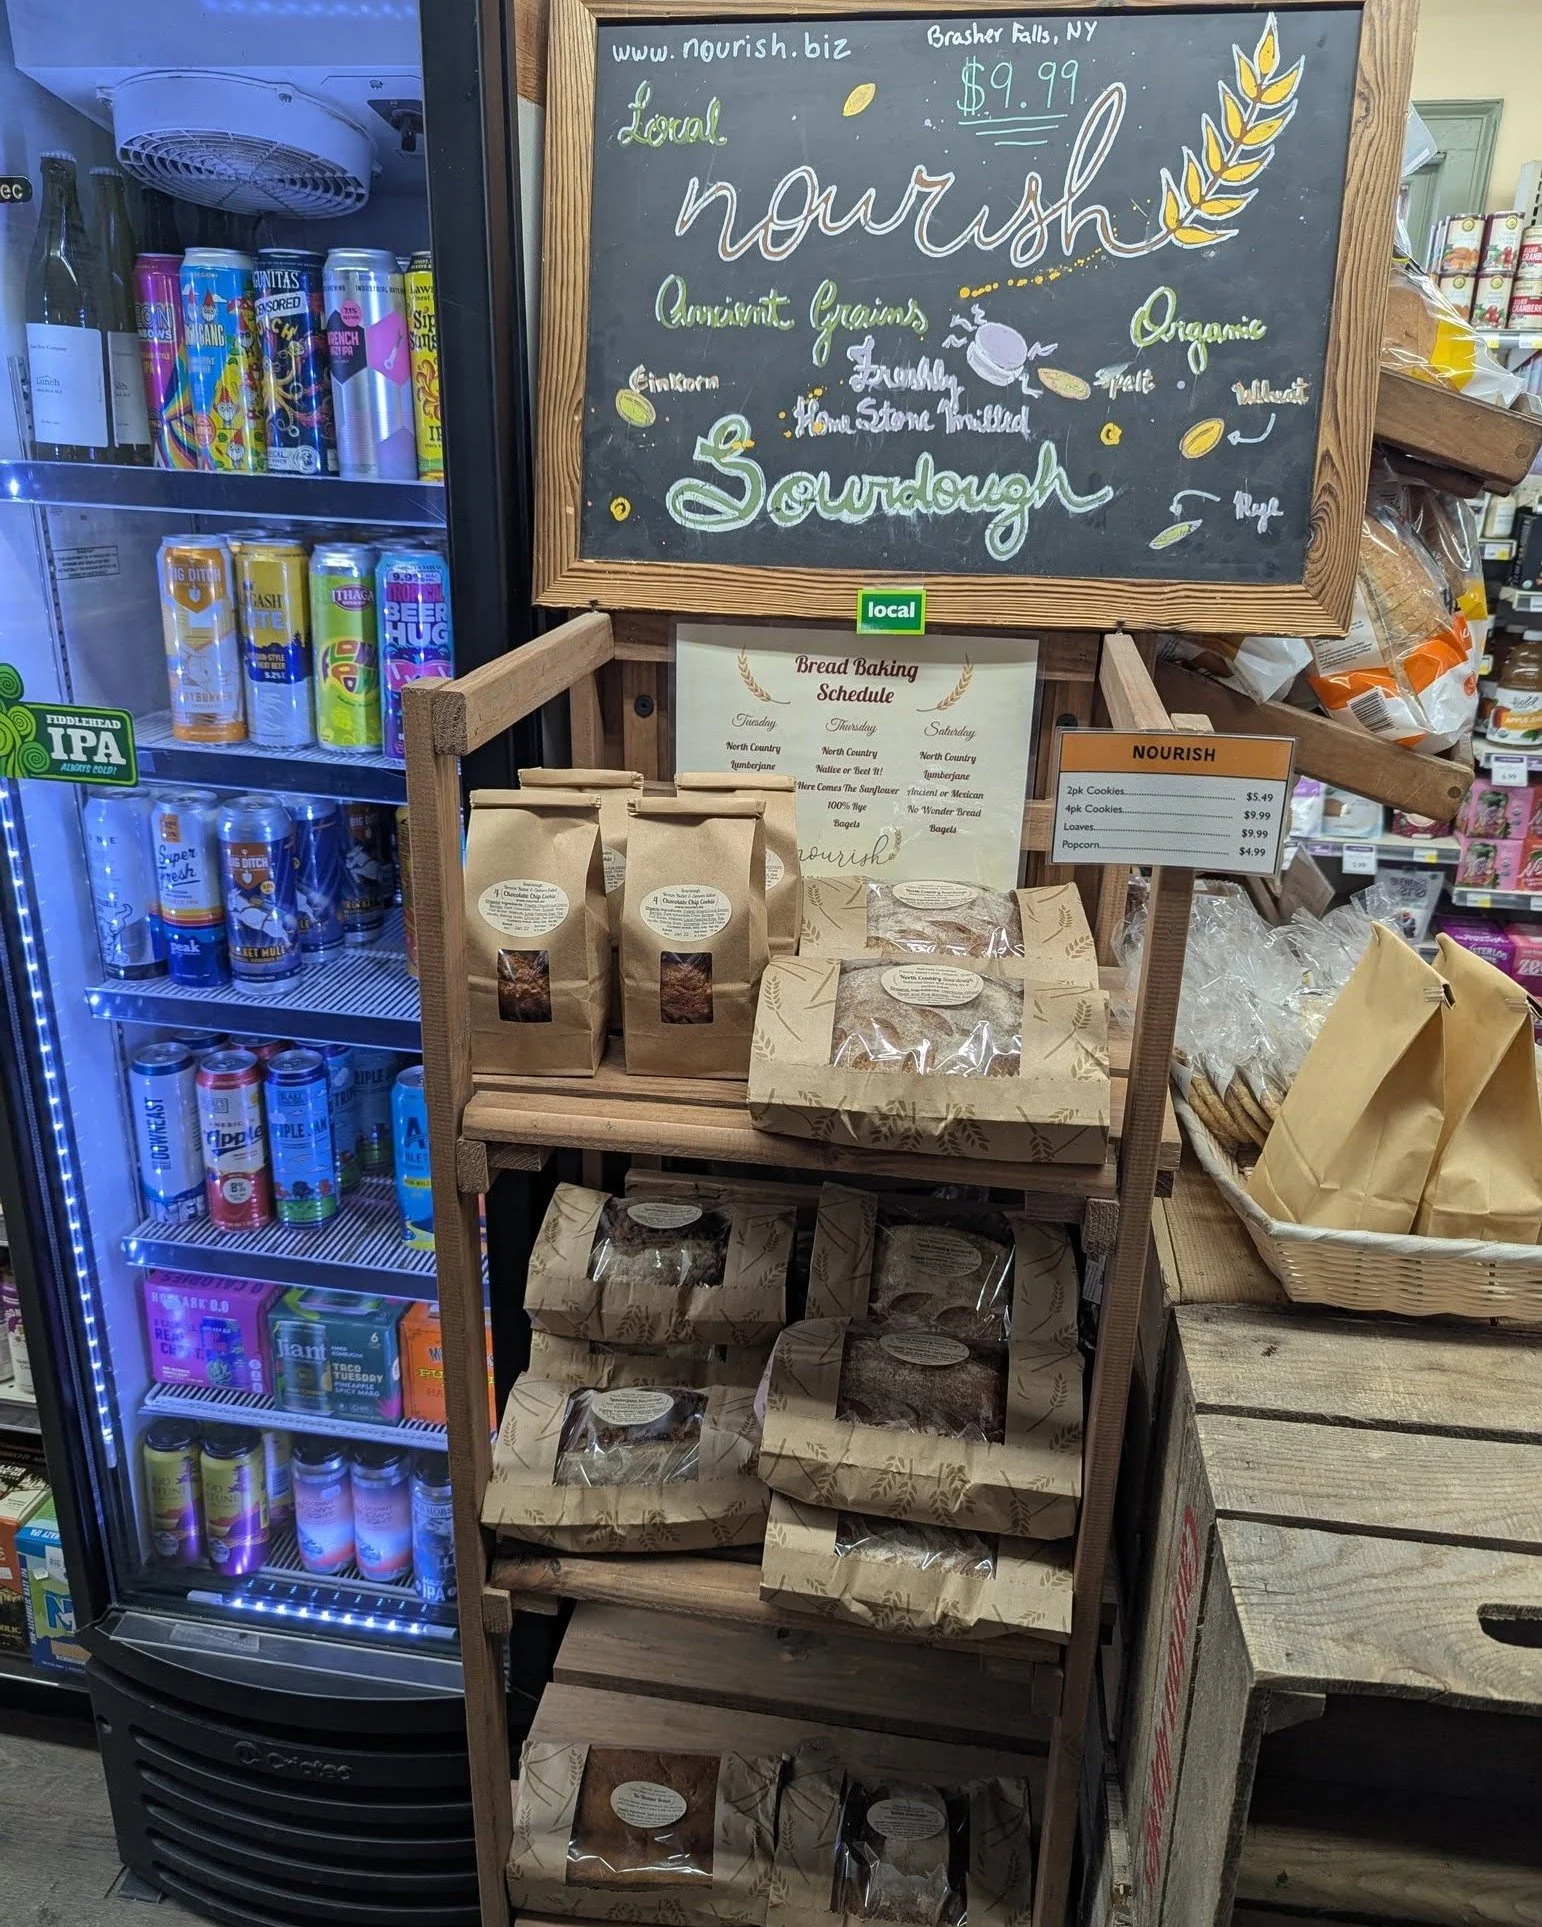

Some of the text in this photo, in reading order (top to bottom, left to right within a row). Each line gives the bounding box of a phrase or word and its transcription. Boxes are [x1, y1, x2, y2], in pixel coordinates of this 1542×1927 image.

[926, 21, 1098, 47] Brasher Falls, NY
[612, 37, 851, 62] www.nourish.biz
[957, 57, 1078, 117] $9.99
[617, 80, 728, 147] Local
[676, 83, 1165, 267] nourish
[655, 275, 928, 367] Ancient Grains
[1130, 285, 1267, 374] Organic
[847, 334, 966, 400] Freshly
[628, 364, 720, 395] Einkorn
[1231, 377, 1310, 405] Wheat
[793, 396, 857, 438] Home
[856, 397, 935, 434] Stone
[665, 413, 1114, 562] Sourdough
[1232, 490, 1285, 534] Rye
[386, 602, 449, 623] BEER
[867, 599, 917, 622] local
[388, 621, 449, 648] HUG
[795, 655, 919, 683] Bread Baking
[816, 683, 895, 704] Schedule
[45, 714, 121, 730] FIDDLEHEAD
[731, 712, 777, 731] Tuesday
[825, 718, 878, 737] Thursday
[923, 721, 976, 741] Saturday
[47, 727, 127, 765] IPA
[725, 741, 781, 755] North Country
[821, 746, 878, 760] North Country
[1132, 745, 1216, 761] NOURISH
[730, 760, 776, 772] Lumberjane
[919, 751, 977, 764] North Country
[60, 763, 118, 775] ALWAYS COLD!
[815, 764, 840, 776] Native
[842, 767, 852, 776] or
[922, 769, 971, 782] Lumberjane
[797, 781, 900, 797] Here Comes The Sunflower
[906, 788, 984, 801] Ancient or Mexican
[1067, 786, 1274, 802] 2pk Cookies $5.49
[827, 801, 867, 814] 100% Rye
[906, 804, 982, 818] No Wonder Bread
[1065, 804, 1271, 821] 4pk Cookies $9.99
[832, 818, 860, 831] Bagels
[928, 823, 958, 836] Bagels
[1063, 822, 1269, 839] Loaves $9.99
[159, 845, 198, 869] Super
[1062, 840, 1266, 857] Popcorn $4.99
[503, 891, 529, 899] Chocolate
[530, 892, 542, 900] Chip
[332, 1363, 361, 1373] TACO
[334, 1371, 384, 1384] TUESDAY
